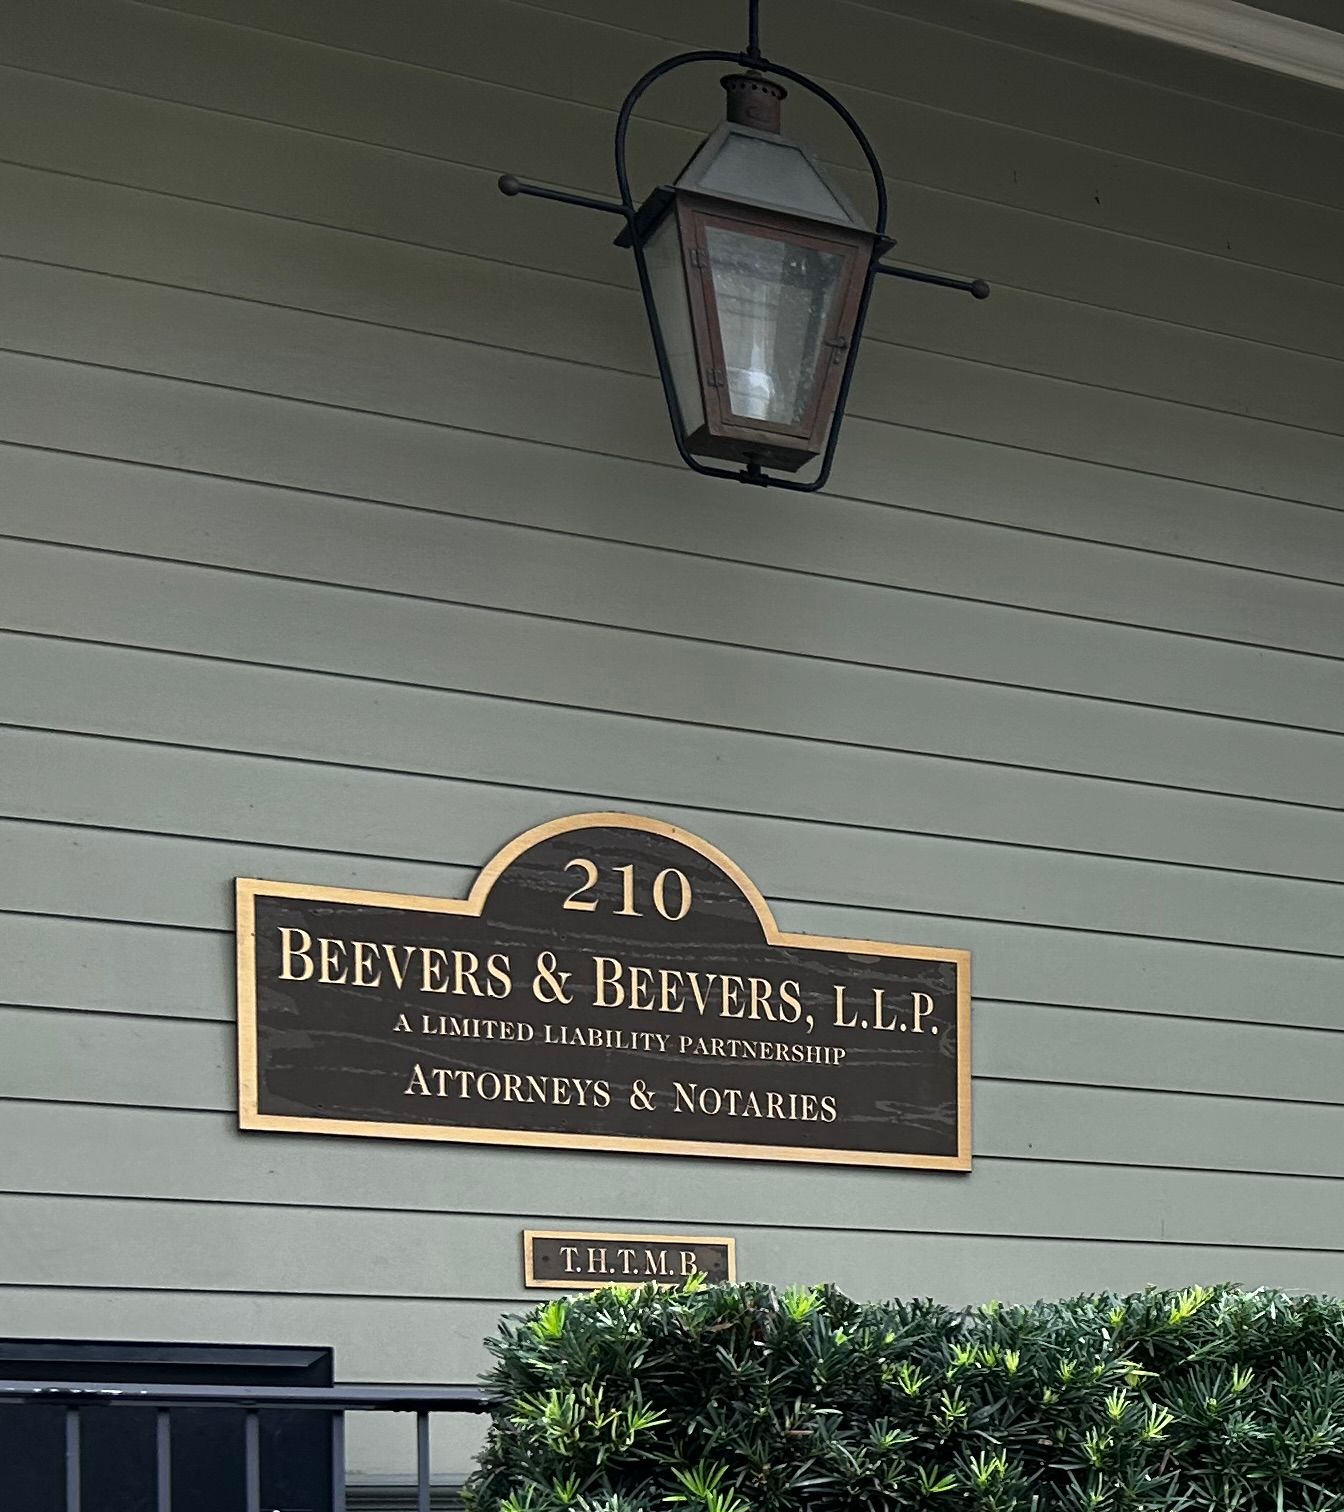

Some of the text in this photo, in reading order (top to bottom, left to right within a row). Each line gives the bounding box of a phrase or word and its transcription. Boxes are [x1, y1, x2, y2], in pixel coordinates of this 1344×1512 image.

[563, 858, 693, 922] 210
[276, 926, 941, 1035] BEEVERS & BEEVERS, L.L.P.
[393, 1014, 848, 1067] A LIMITED LIABILITY PARTNERSHIP
[404, 1063, 838, 1124] ATTORNEYS & NOTARIES
